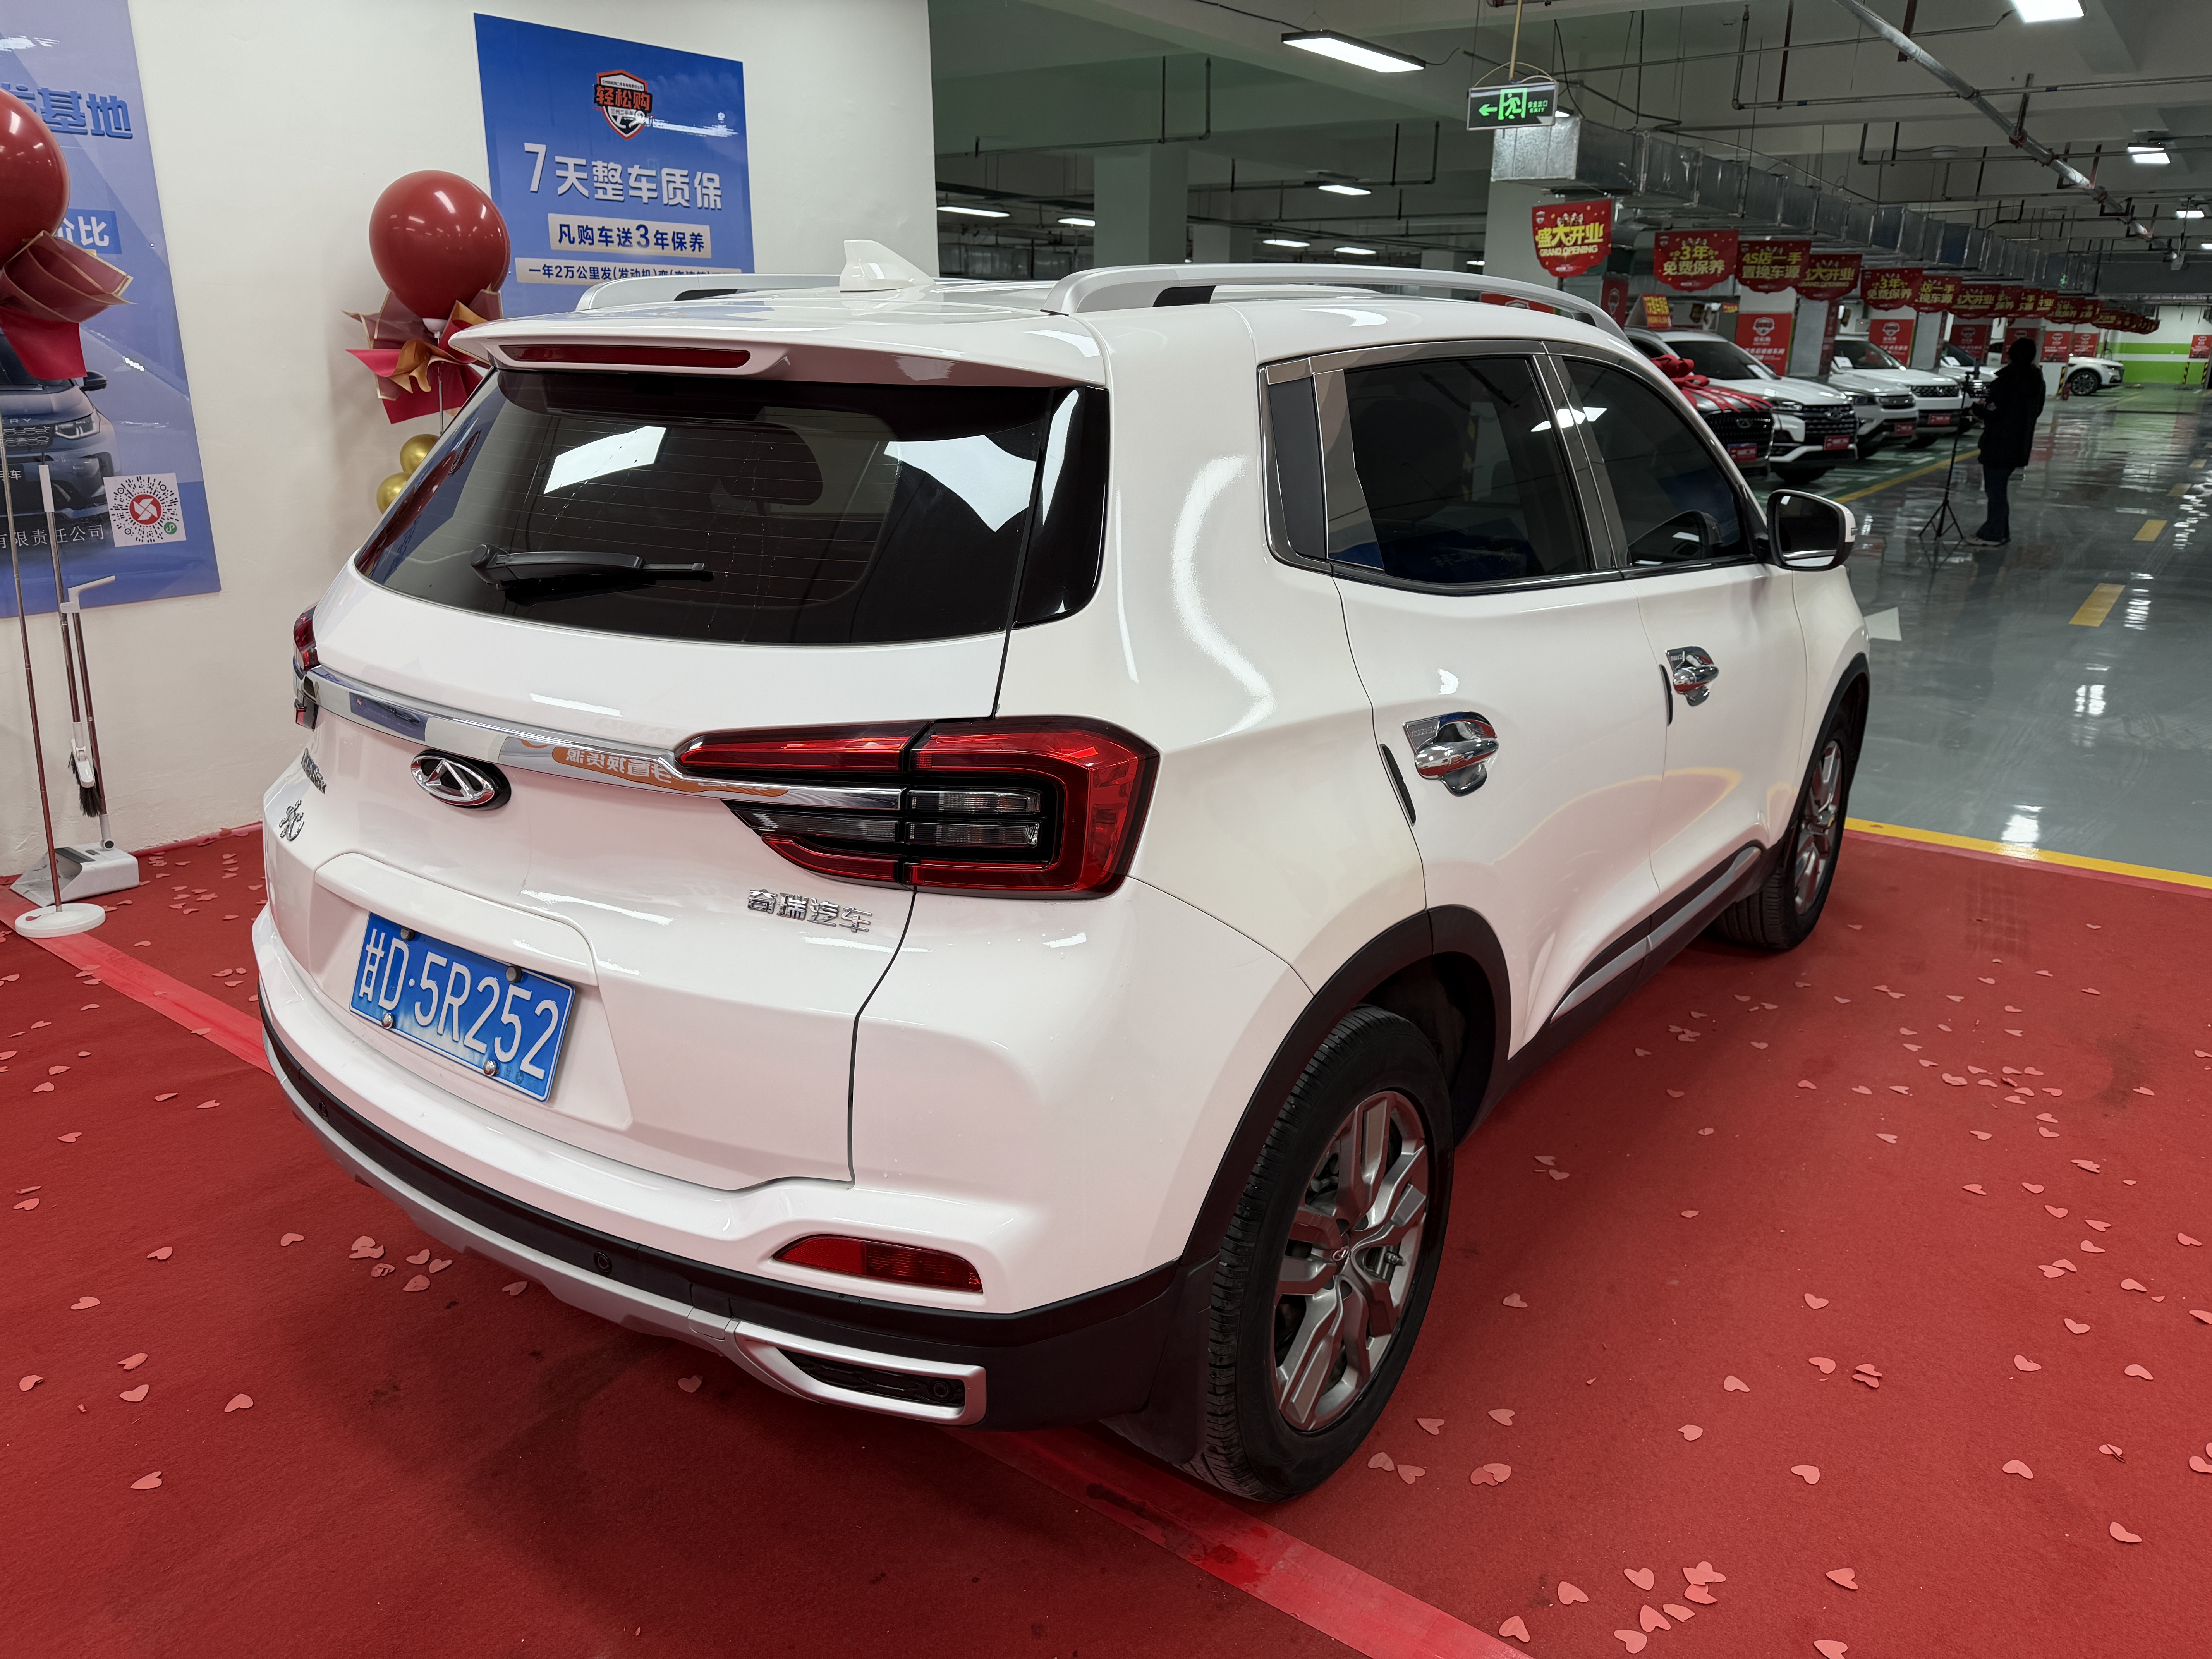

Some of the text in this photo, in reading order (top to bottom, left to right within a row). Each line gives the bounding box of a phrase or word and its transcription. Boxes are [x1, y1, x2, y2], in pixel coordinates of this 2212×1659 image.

[596, 86, 651, 111] 轻松购
[1528, 100, 1548, 108] 安全出口
[524, 143, 722, 210] 7天整车质保
[558, 223, 705, 252] 凡购车送3年保养
[1535, 222, 1605, 248] 盛大开业
[1539, 244, 1598, 257] GRAND OPENING
[1680, 245, 1710, 261] 3年
[1743, 252, 1802, 264] 4S店一手
[1662, 259, 1725, 276] 免费保养
[1742, 265, 1801, 279] 置换车源
[1879, 278, 1901, 289] 3年
[1921, 283, 1955, 294] 店一手
[1867, 288, 1912, 300] 免费保养
[1915, 293, 1954, 304] 换车源
[747, 888, 872, 933] 奇瑞汽车
[359, 928, 559, 1080] 甘D·5R252
